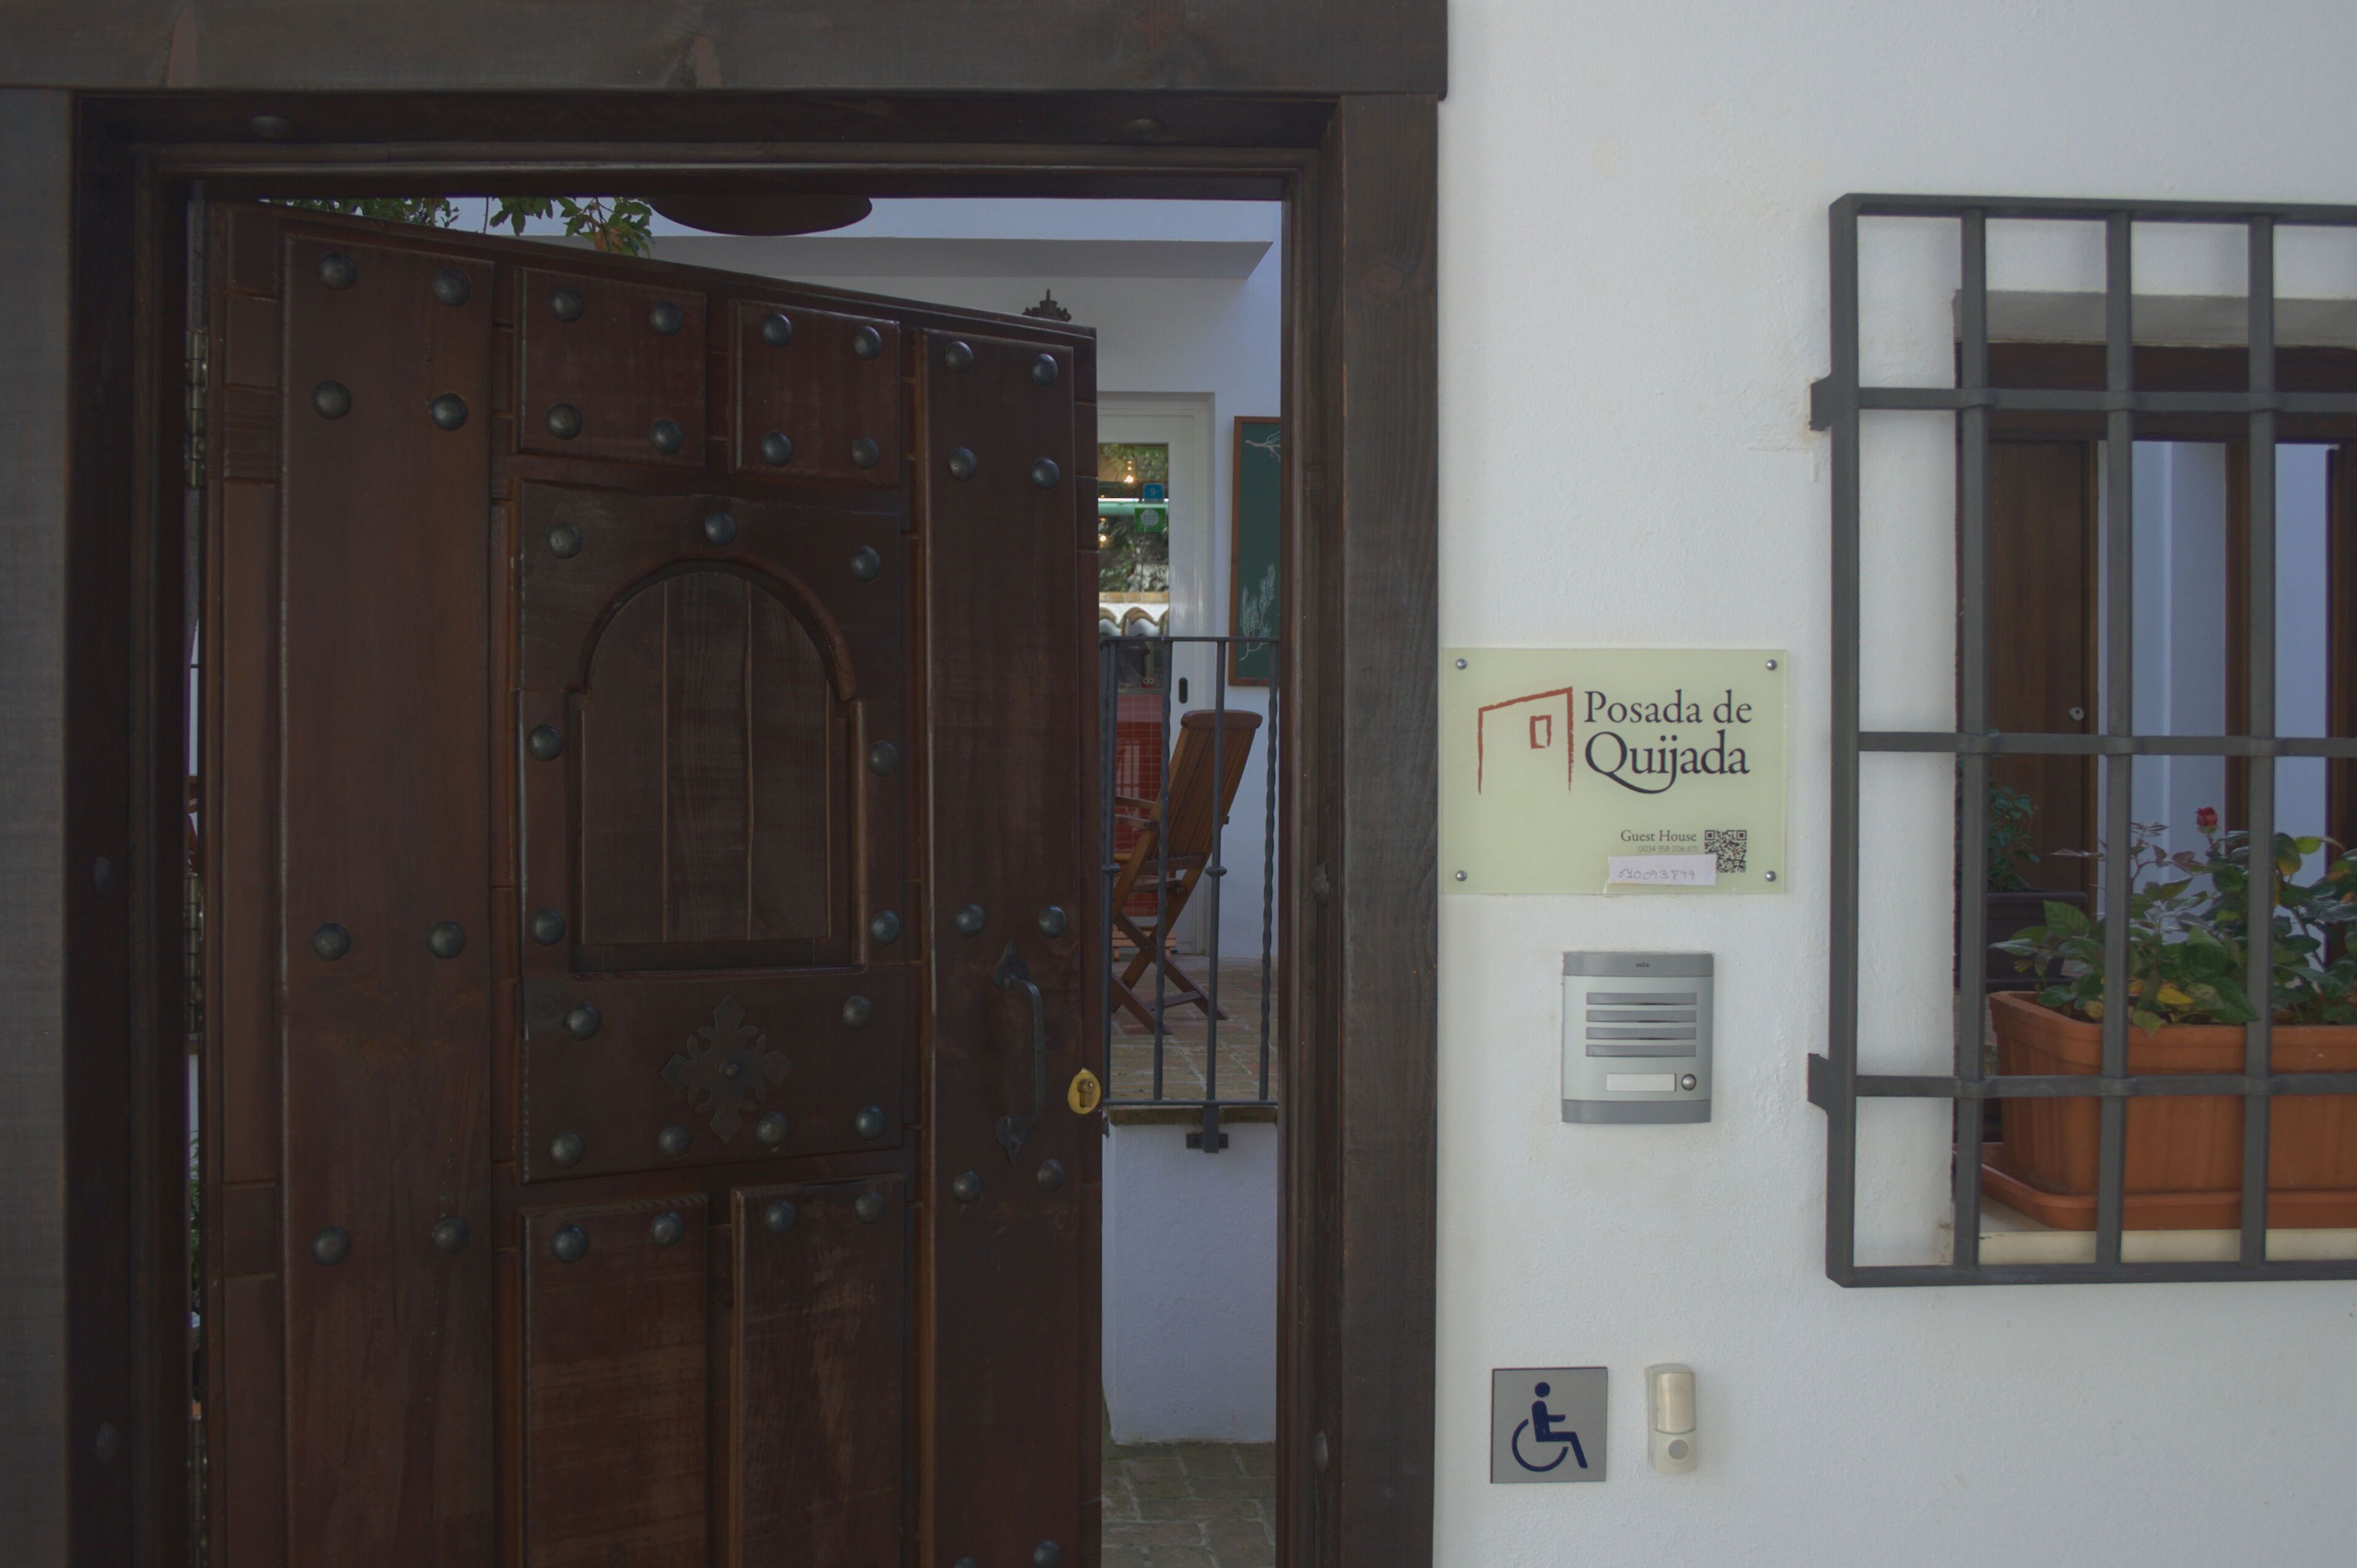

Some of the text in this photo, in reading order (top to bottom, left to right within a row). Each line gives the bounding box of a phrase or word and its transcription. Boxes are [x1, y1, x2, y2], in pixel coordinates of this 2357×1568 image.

[1584, 689, 1752, 723] Posada de
[1585, 729, 1751, 794] Quijada
[1620, 830, 1697, 841] Guest House
